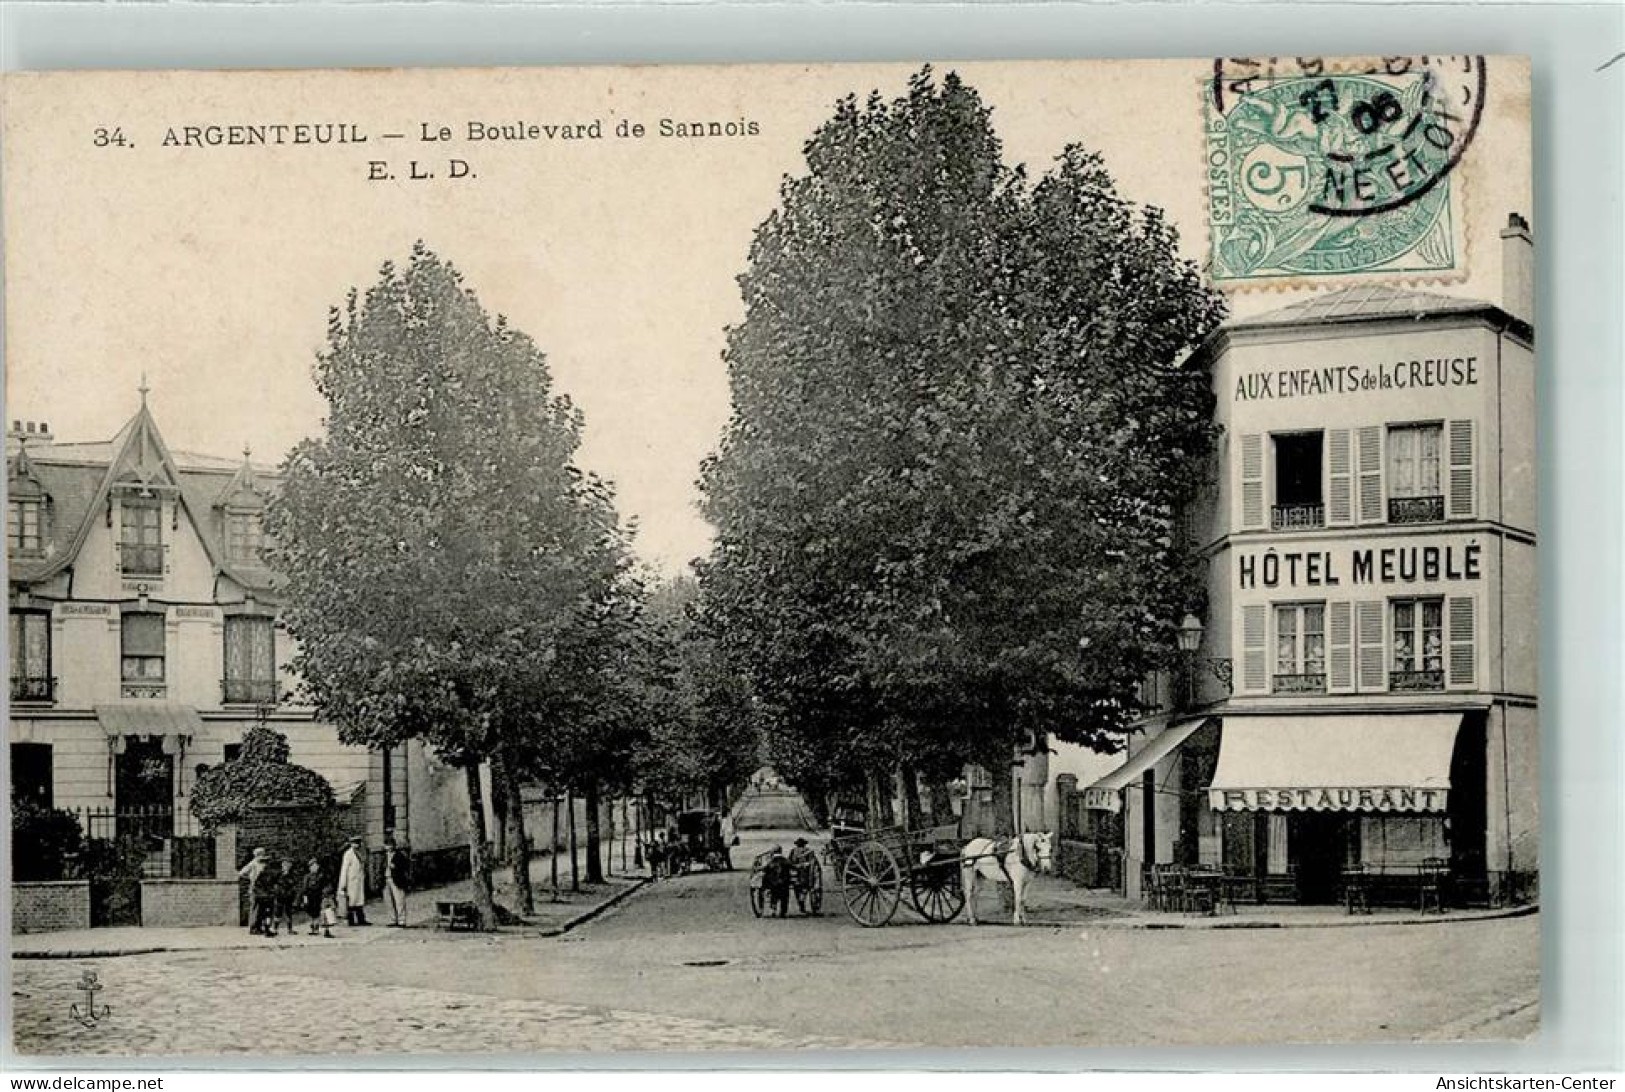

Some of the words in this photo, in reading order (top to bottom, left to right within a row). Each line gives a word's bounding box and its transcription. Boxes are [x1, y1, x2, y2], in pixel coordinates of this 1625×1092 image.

[93, 126, 135, 148] 34.
[162, 124, 367, 147] ARGENTEUIL
[420, 122, 452, 142] Le
[467, 119, 603, 141] Boulevard
[615, 119, 646, 138] de
[659, 117, 761, 137] Sannois
[368, 161, 396, 181] E.
[409, 160, 435, 180] L.
[449, 159, 478, 180] D.
[1209, 134, 1231, 222] POSTES
[1235, 371, 1274, 401] AUX
[1278, 365, 1359, 398] ENFANTS
[1394, 356, 1478, 388] CREUSE
[1240, 547, 1340, 589] HÔTEL
[1352, 538, 1482, 584] MEUBLÉ
[1223, 788, 1437, 809] RESTAURANT
